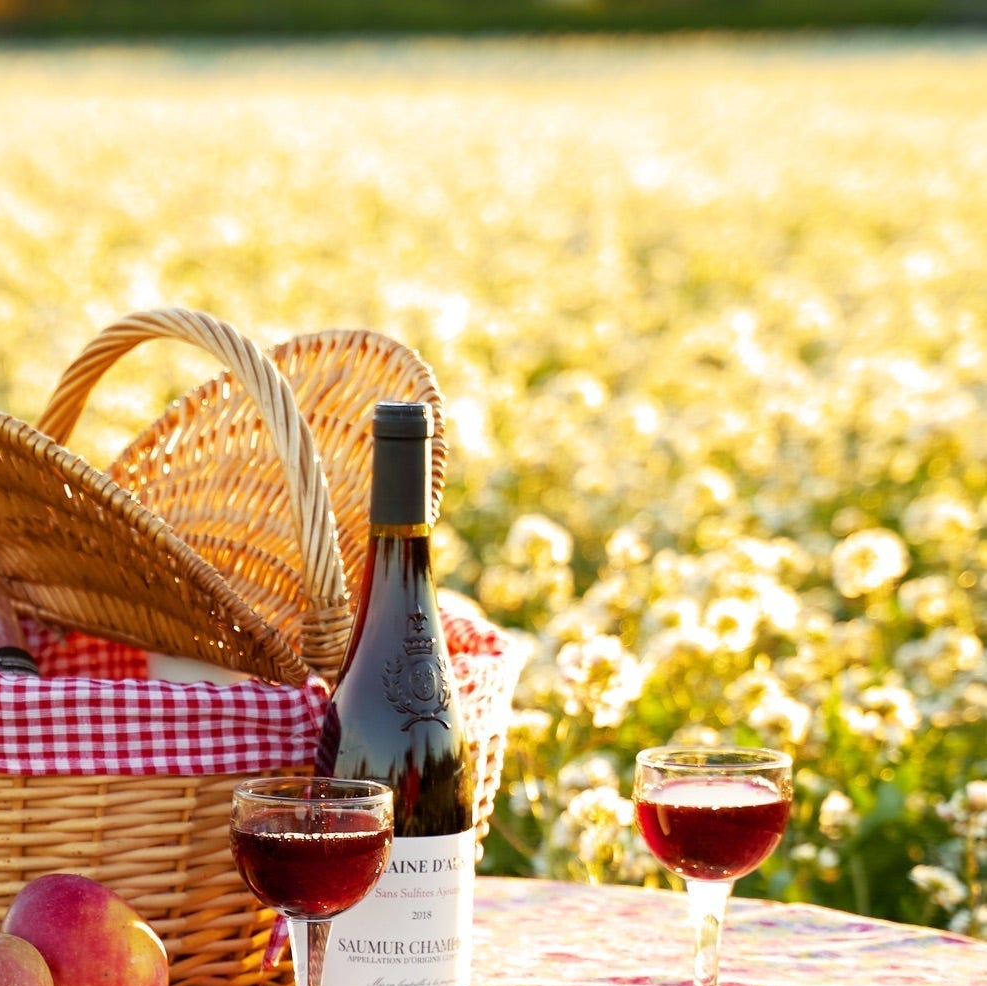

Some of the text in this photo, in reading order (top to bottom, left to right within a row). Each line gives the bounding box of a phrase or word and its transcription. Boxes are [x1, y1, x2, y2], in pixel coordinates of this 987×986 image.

[384, 860, 428, 874] AINE
[375, 888, 398, 898] Sans
[400, 887, 434, 898] Sulfites
[411, 910, 432, 920] 2018
[338, 936, 461, 954] SAUMUR CHAMP
[347, 955, 402, 965] APPELLATION
[403, 955, 441, 965] D'ORIGINE
